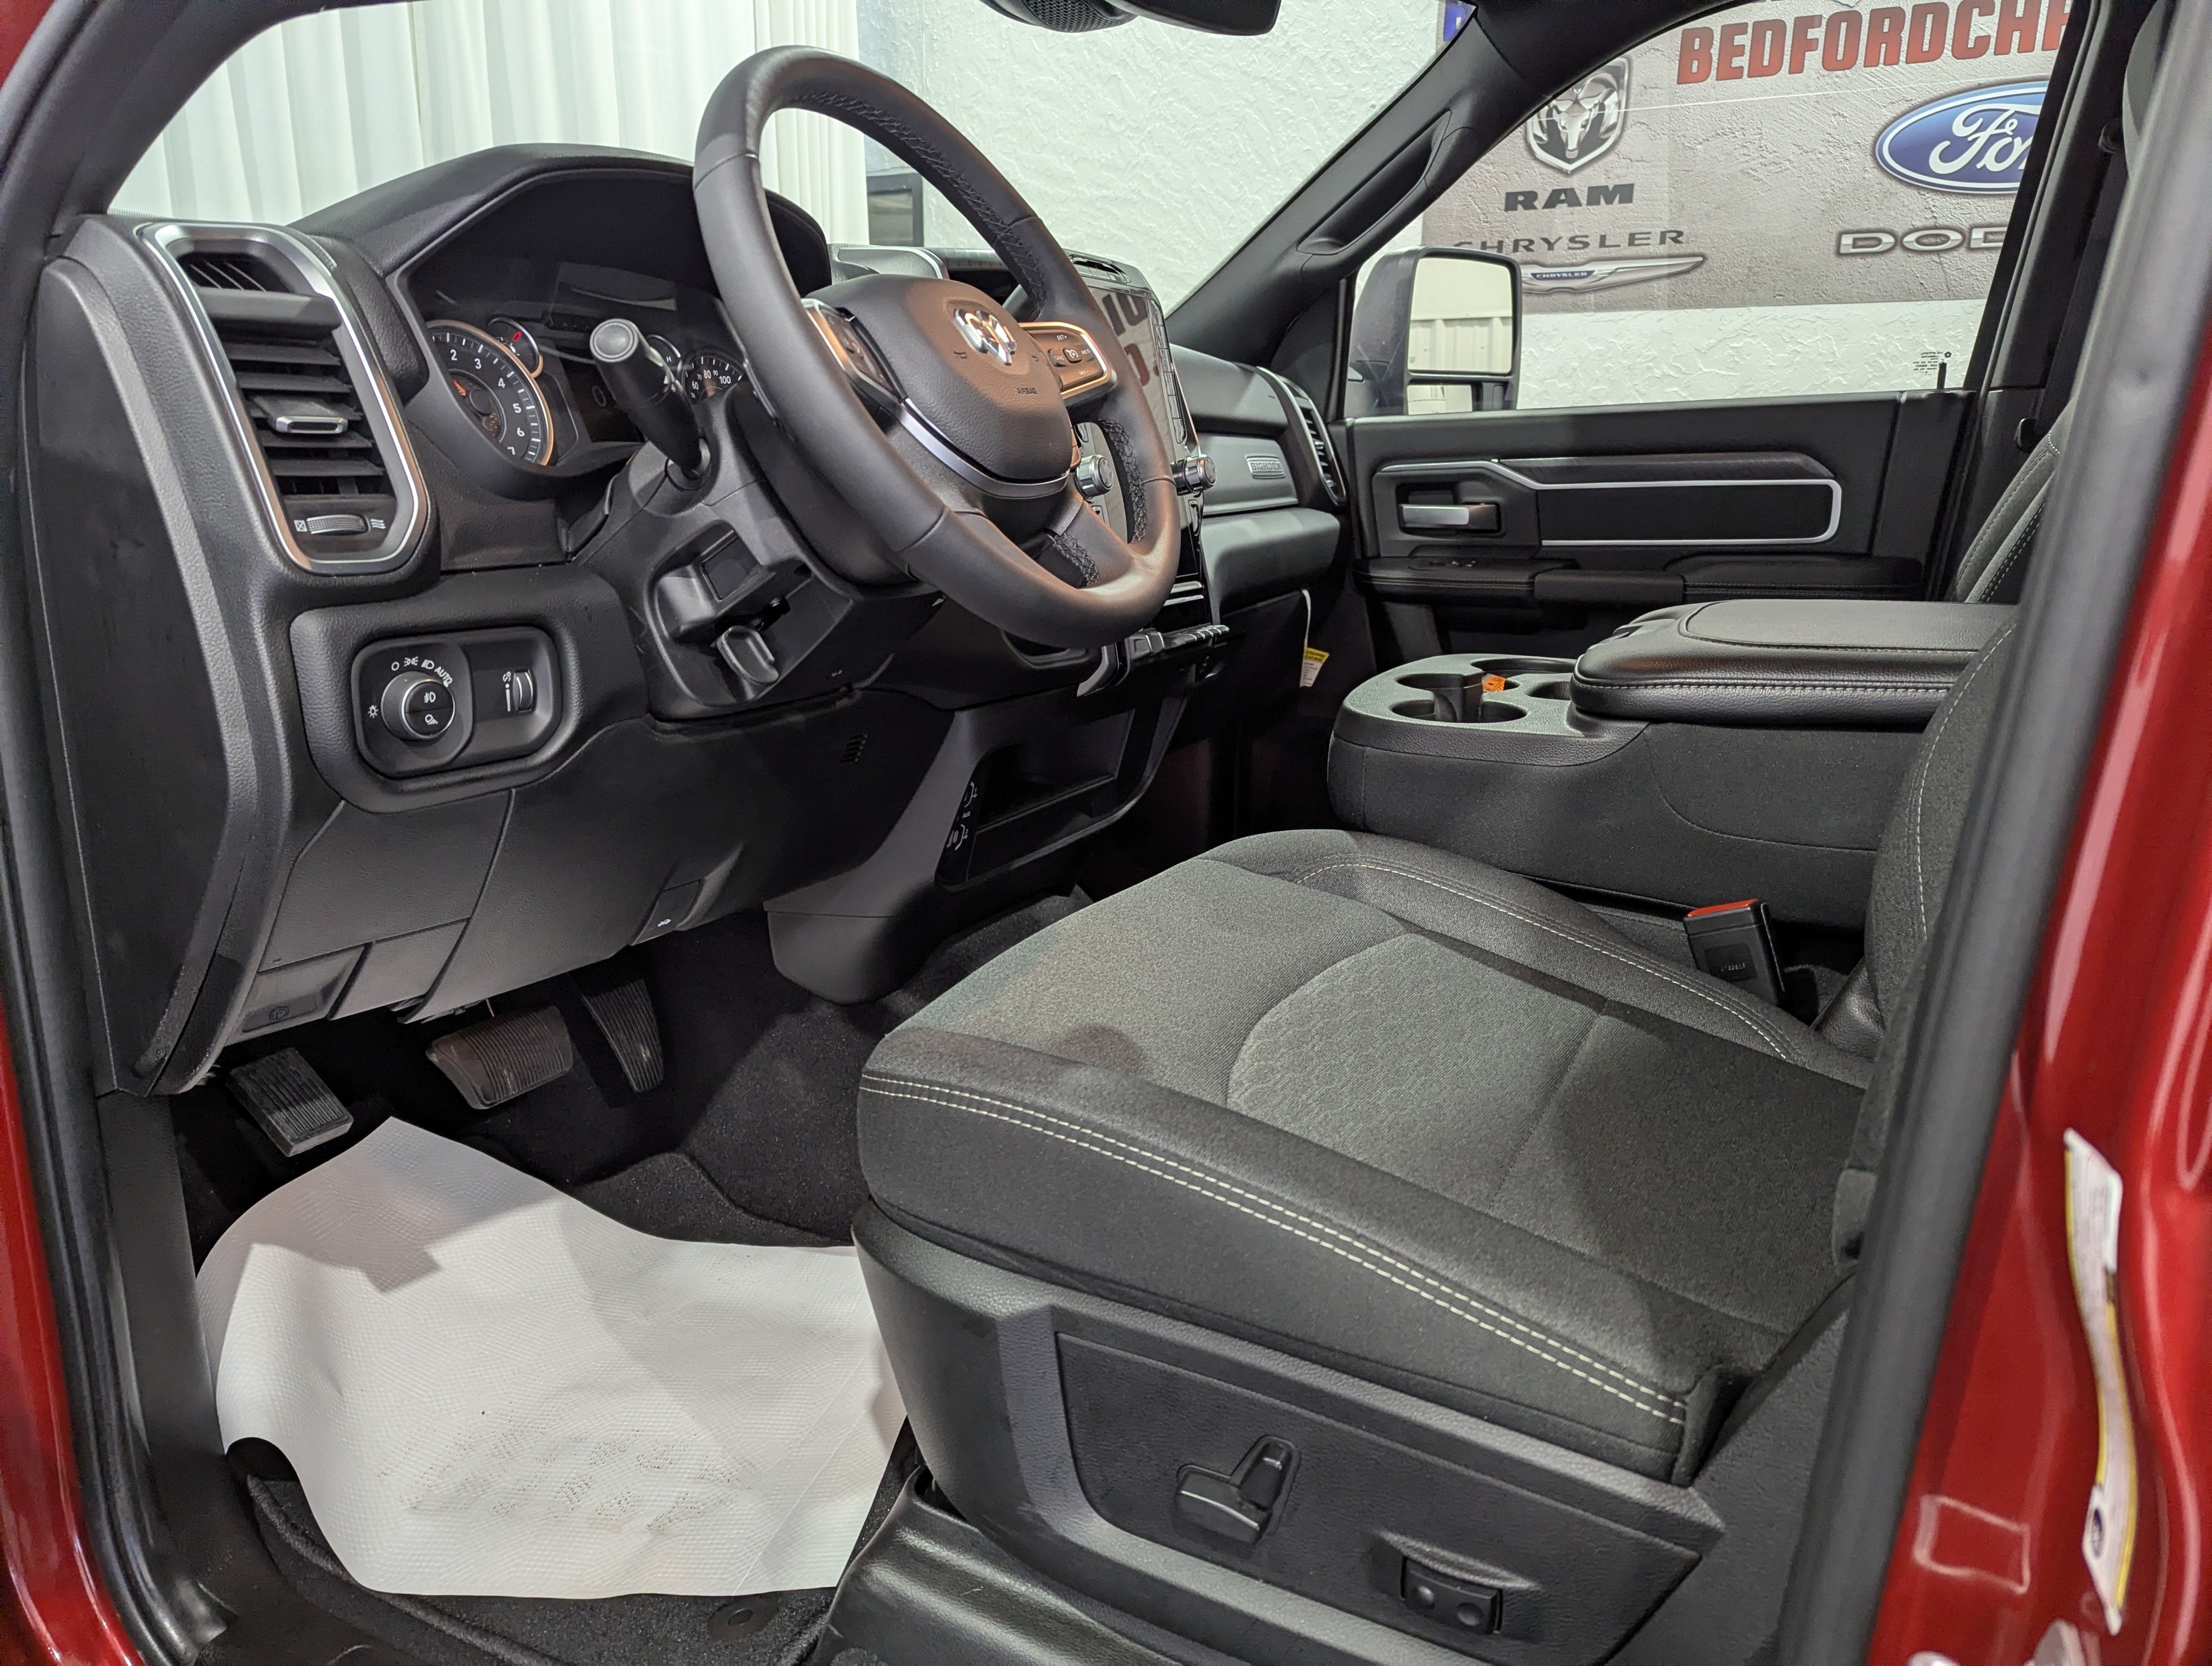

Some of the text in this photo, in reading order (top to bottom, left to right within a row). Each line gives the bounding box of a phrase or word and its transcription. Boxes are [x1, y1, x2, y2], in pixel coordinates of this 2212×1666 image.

[1929, 103, 2042, 174] Fo
[1504, 183, 1635, 212] RAM
[1840, 226, 2008, 254] DOD
[450, 349, 458, 361] 2
[474, 358, 482, 369] 3
[703, 369, 711, 379] 80
[498, 377, 505, 388] 4
[692, 381, 699, 390] 60
[719, 375, 731, 385] 100
[512, 403, 522, 413] 5
[516, 427, 525, 437] 6
[507, 446, 515, 456] 7
[434, 666, 453, 684] AUTO
